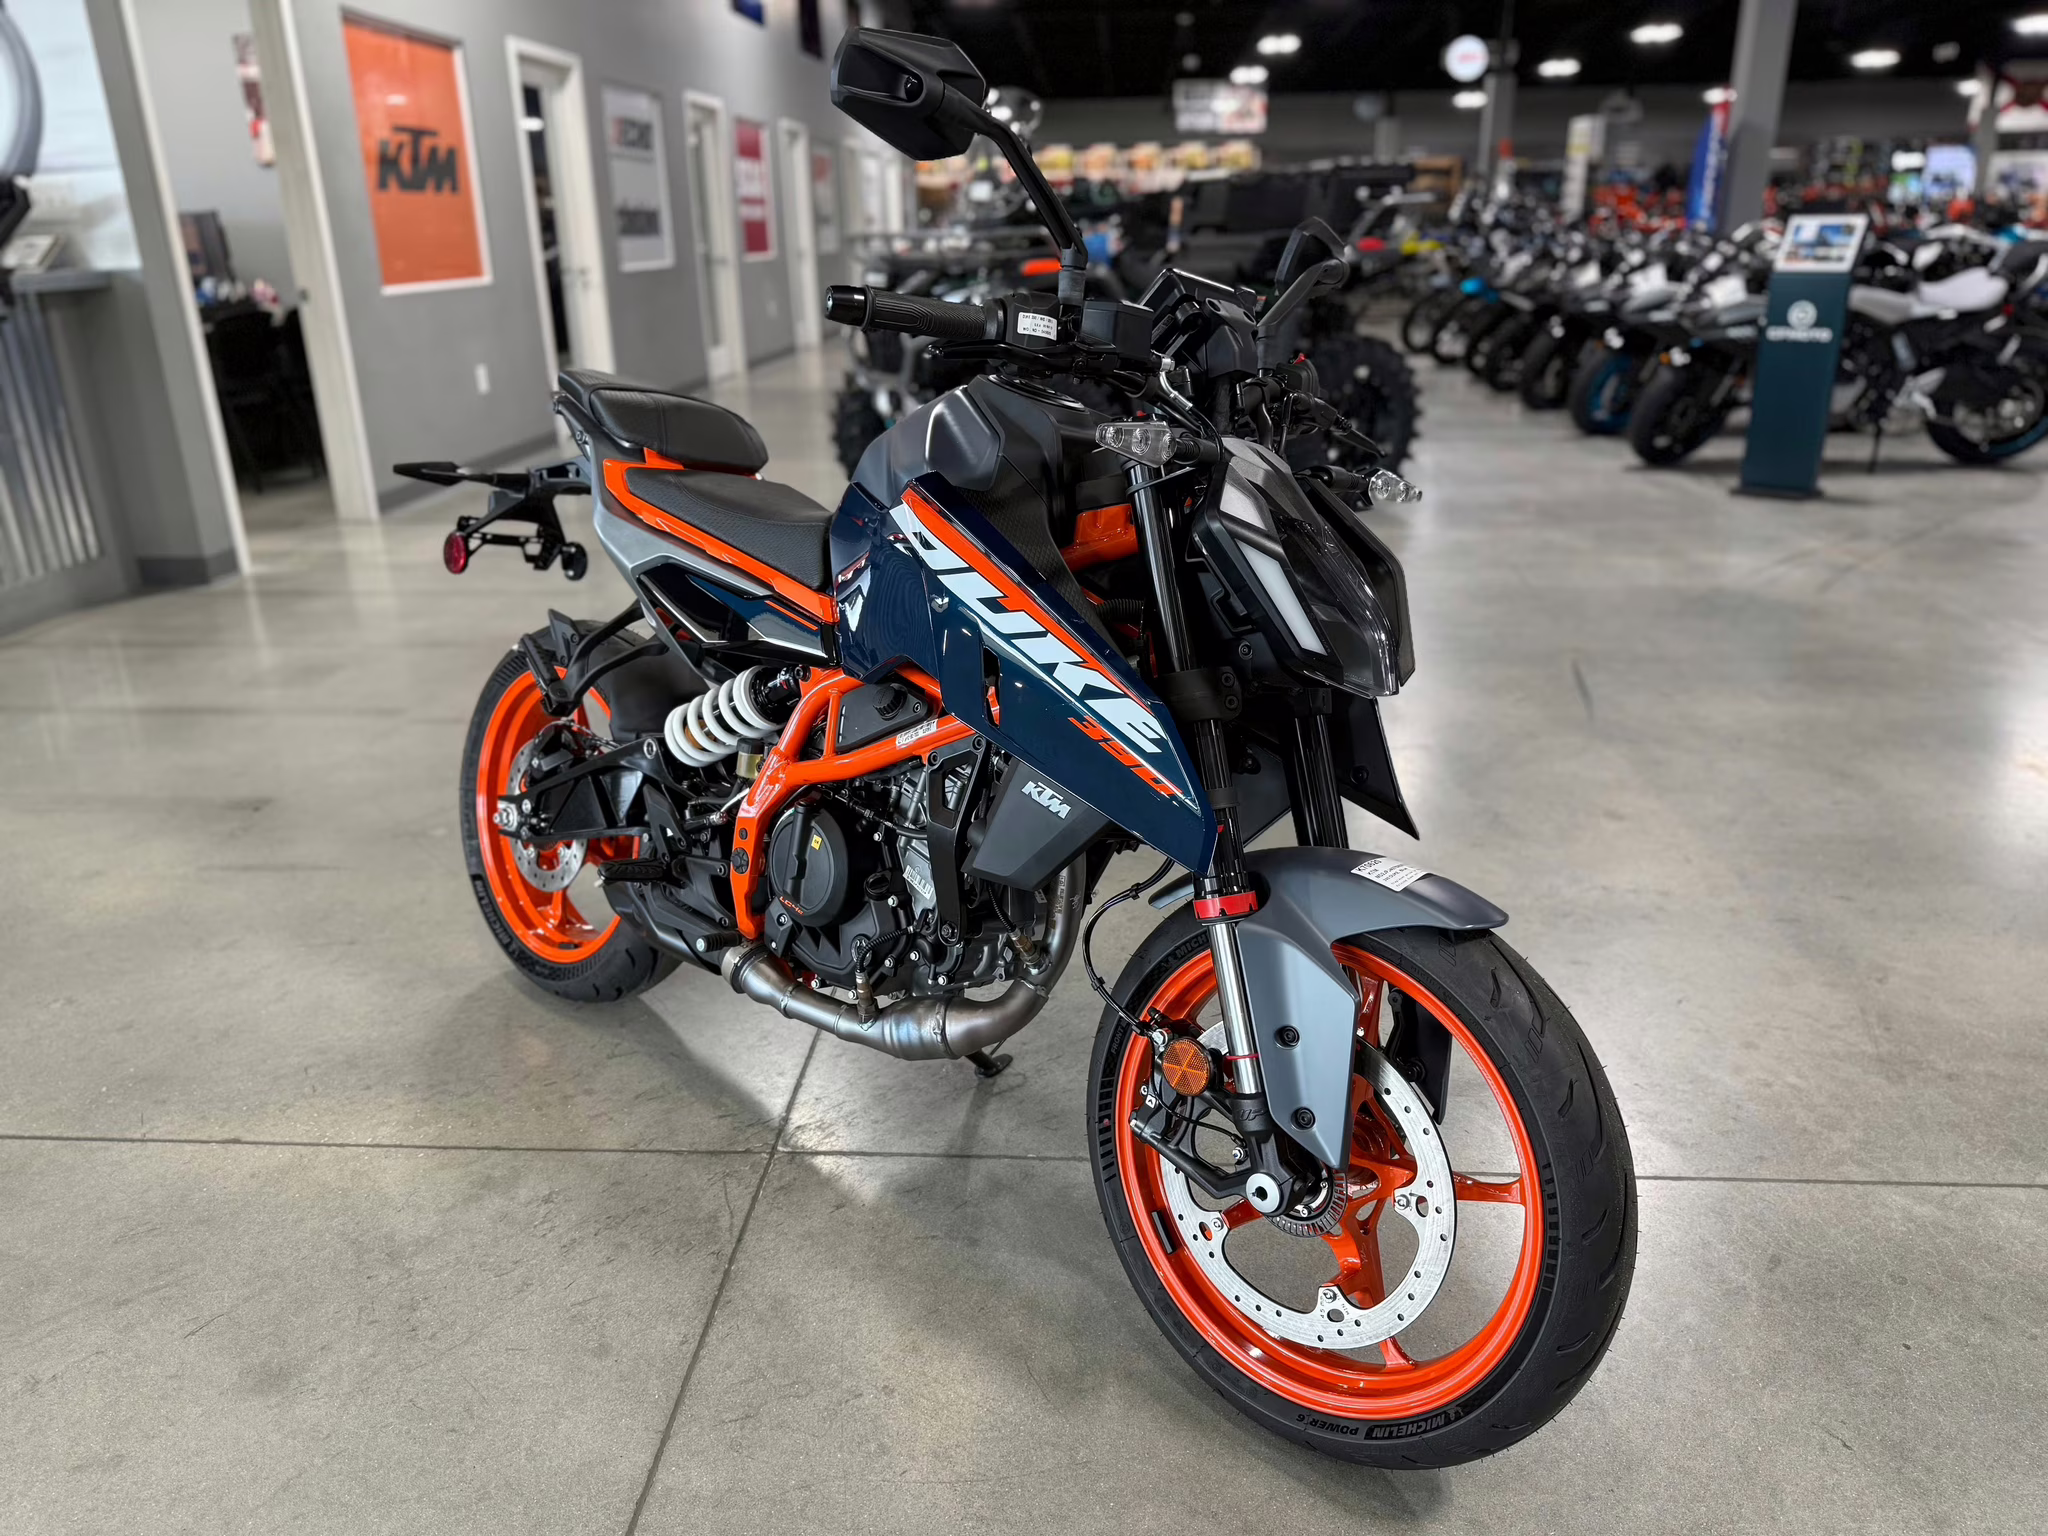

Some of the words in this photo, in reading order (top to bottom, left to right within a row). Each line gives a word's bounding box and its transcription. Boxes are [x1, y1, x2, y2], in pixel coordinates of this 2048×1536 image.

[378, 126, 458, 193] KTM
[889, 503, 1167, 753] DUKE
[1021, 781, 1072, 820] KTM
[1176, 931, 1211, 957] MICH
[1296, 1413, 1305, 1422] 6
[1309, 1417, 1359, 1435] POWER
[1372, 1411, 1445, 1438] MICHELIN
